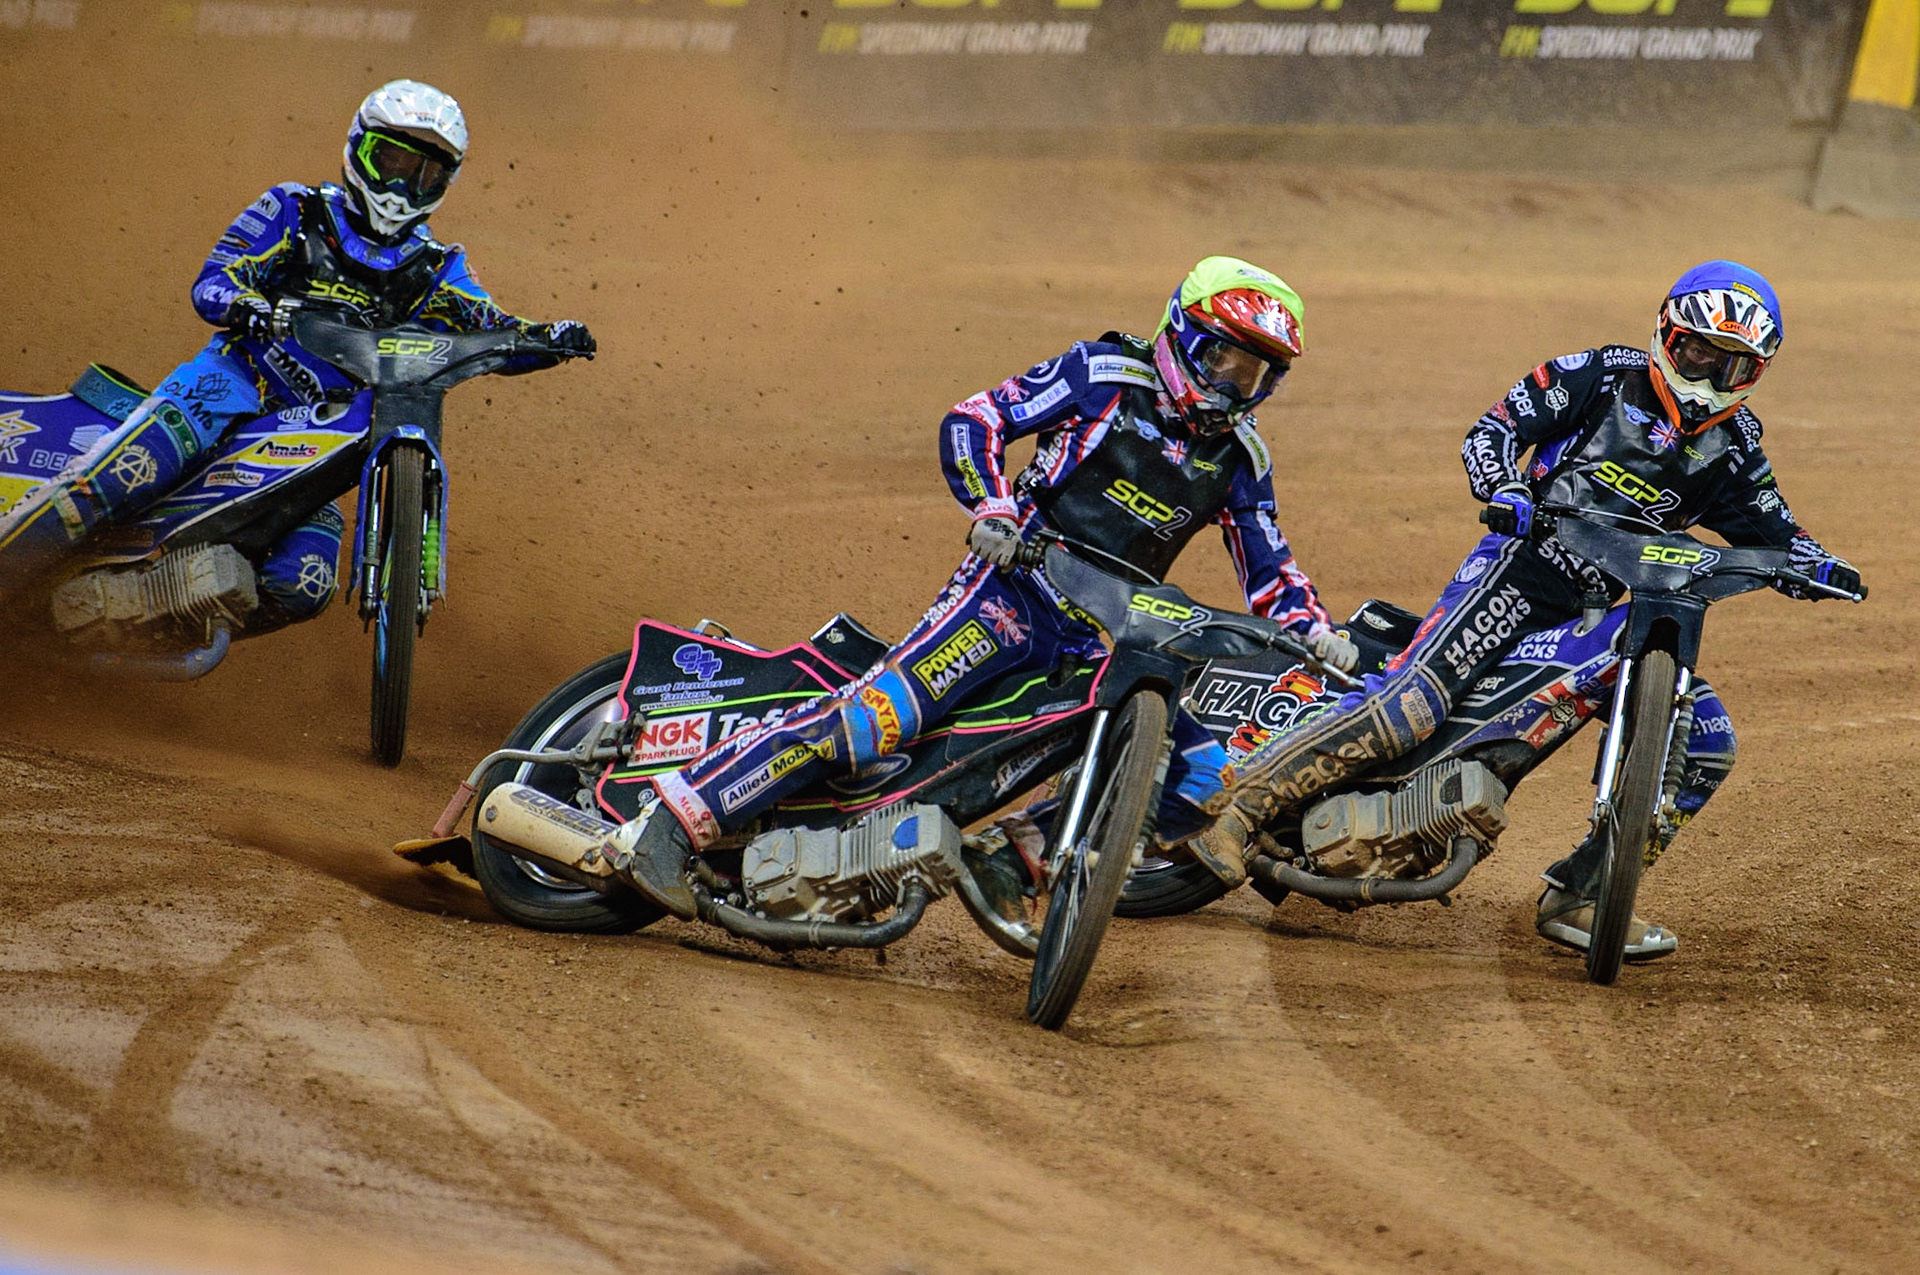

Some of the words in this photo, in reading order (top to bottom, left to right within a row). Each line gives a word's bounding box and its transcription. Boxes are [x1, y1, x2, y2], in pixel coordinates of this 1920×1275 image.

[1204, 22, 1311, 56] SPEEDWAY
[1308, 23, 1380, 56] GRAND
[1378, 24, 1431, 57] PRIX
[1537, 26, 1641, 59] SPEEDWAY
[1640, 27, 1712, 60] GRAND
[1709, 28, 1762, 60] PRIX
[376, 337, 453, 365] SGP2
[1603, 348, 1650, 360] HAGON
[1030, 382, 1069, 413] TYSERS
[956, 426, 966, 458] Allied
[1733, 412, 1755, 453] HOCKS
[1105, 478, 1193, 542] SGP2
[1593, 460, 1682, 526] SGP2
[1641, 545, 1721, 578] SGP2
[1129, 593, 1213, 637] SGP2
[1443, 583, 1521, 667] HAGON
[917, 625, 983, 683] POWER
[1454, 597, 1532, 681] SHOCKS
[1504, 644, 1559, 660] OCKS
[928, 637, 993, 696] MAXED
[672, 677, 745, 692] Henderson
[1474, 676, 1506, 692] ger
[860, 686, 901, 757] SMYTHS
[1199, 679, 1333, 733] HAG
[637, 716, 704, 750] NGK
[1699, 715, 1732, 735] hag
[634, 750, 667, 762] SPARK
[668, 745, 702, 758] PLUGS
[728, 768, 771, 805] Allied
